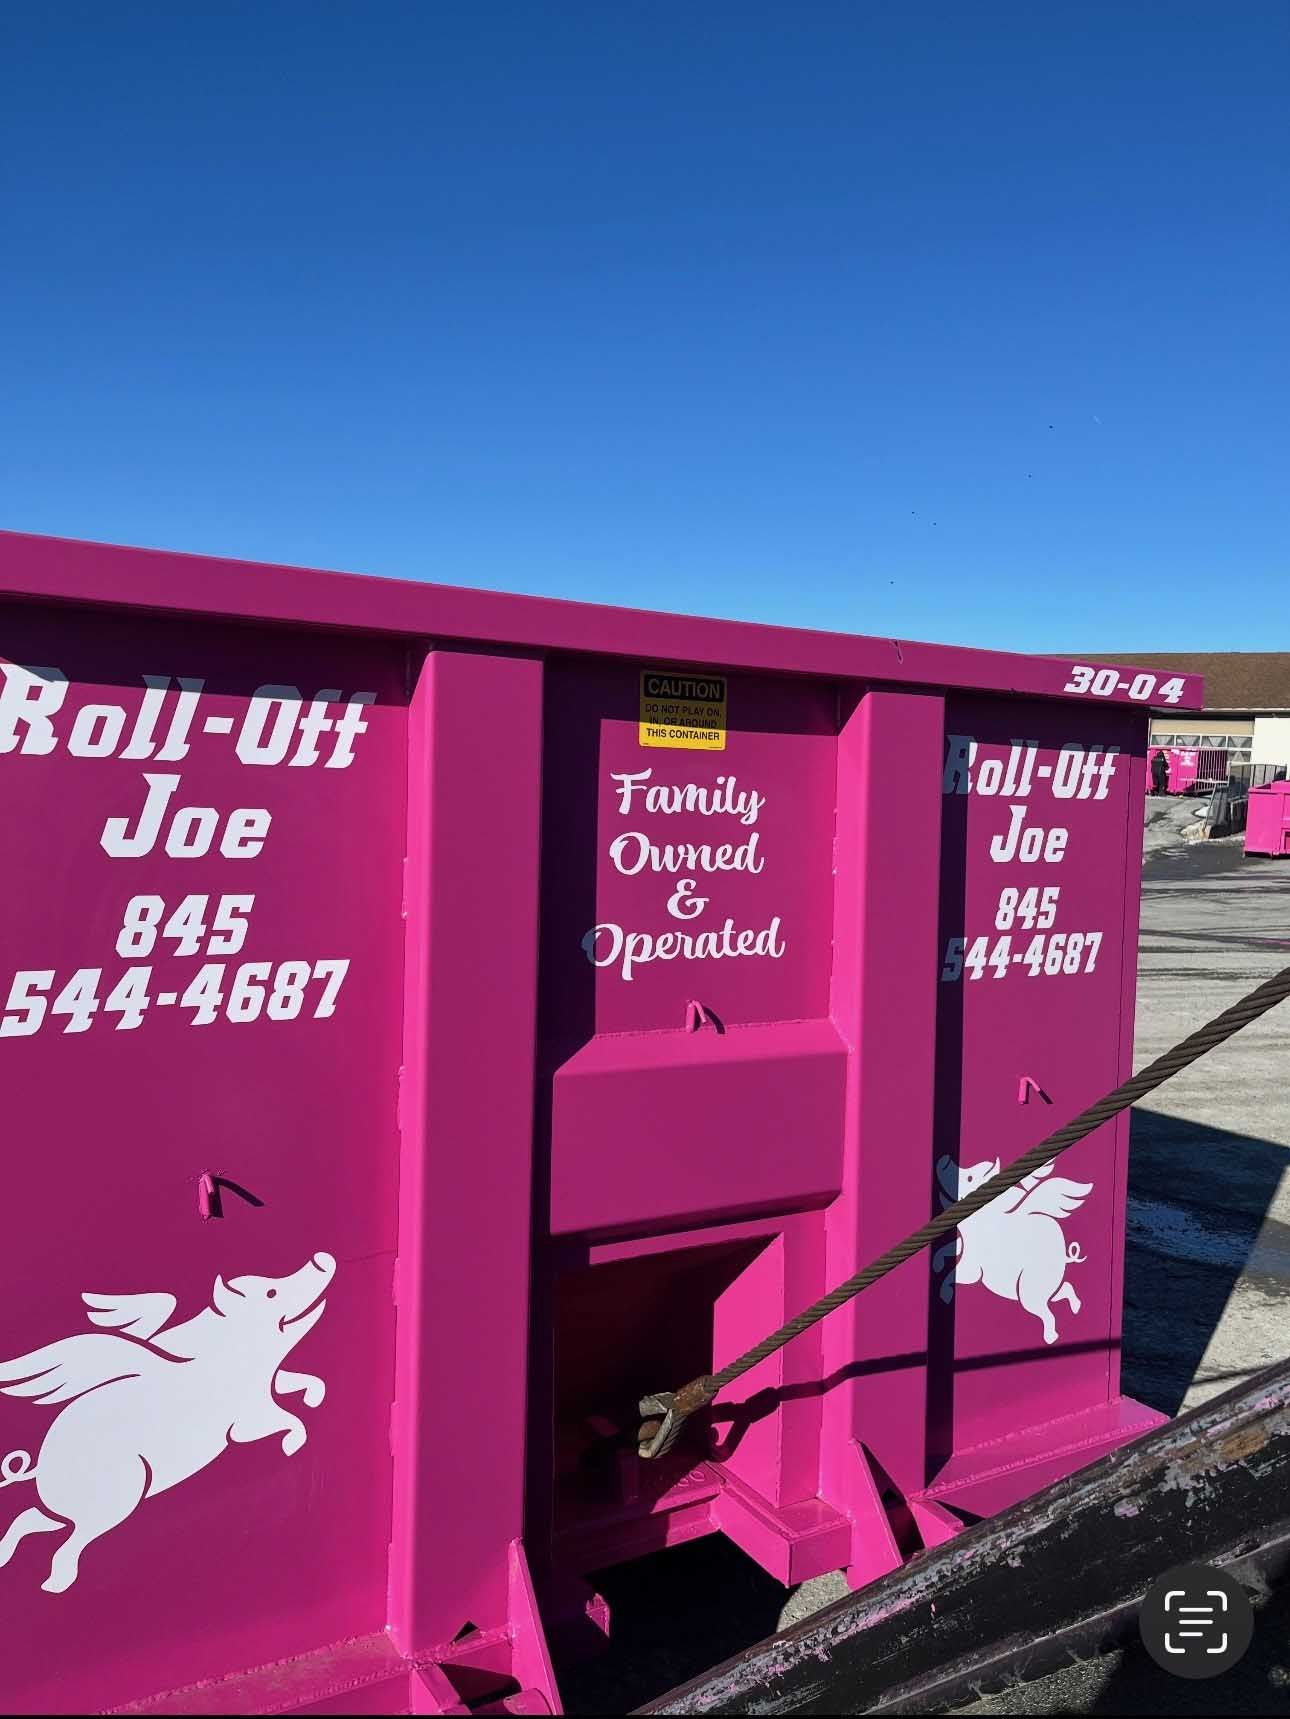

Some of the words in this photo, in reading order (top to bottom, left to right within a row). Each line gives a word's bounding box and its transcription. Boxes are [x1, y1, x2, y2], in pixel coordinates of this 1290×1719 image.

[648, 679, 720, 699] CAUTION
[1063, 666, 1186, 703] 30-04
[0, 663, 377, 768] Roll-Off
[645, 704, 658, 713] DO
[661, 704, 680, 714] NOT
[682, 705, 704, 716] PLAY
[646, 728, 667, 737] THIS
[669, 729, 720, 741] CONTAINER
[679, 718, 717, 729] AROUND
[943, 735, 1120, 799] Roll-Off
[100, 773, 272, 858] Joe
[610, 767, 766, 825] Family
[609, 832, 765, 875] Owned
[989, 805, 1069, 862] Joe
[667, 879, 709, 919] &
[995, 886, 1060, 930] 845
[115, 895, 255, 958] 845
[581, 916, 785, 981] Operated
[941, 932, 1103, 982] 544-4687
[0, 959, 350, 1037] 544-4687
